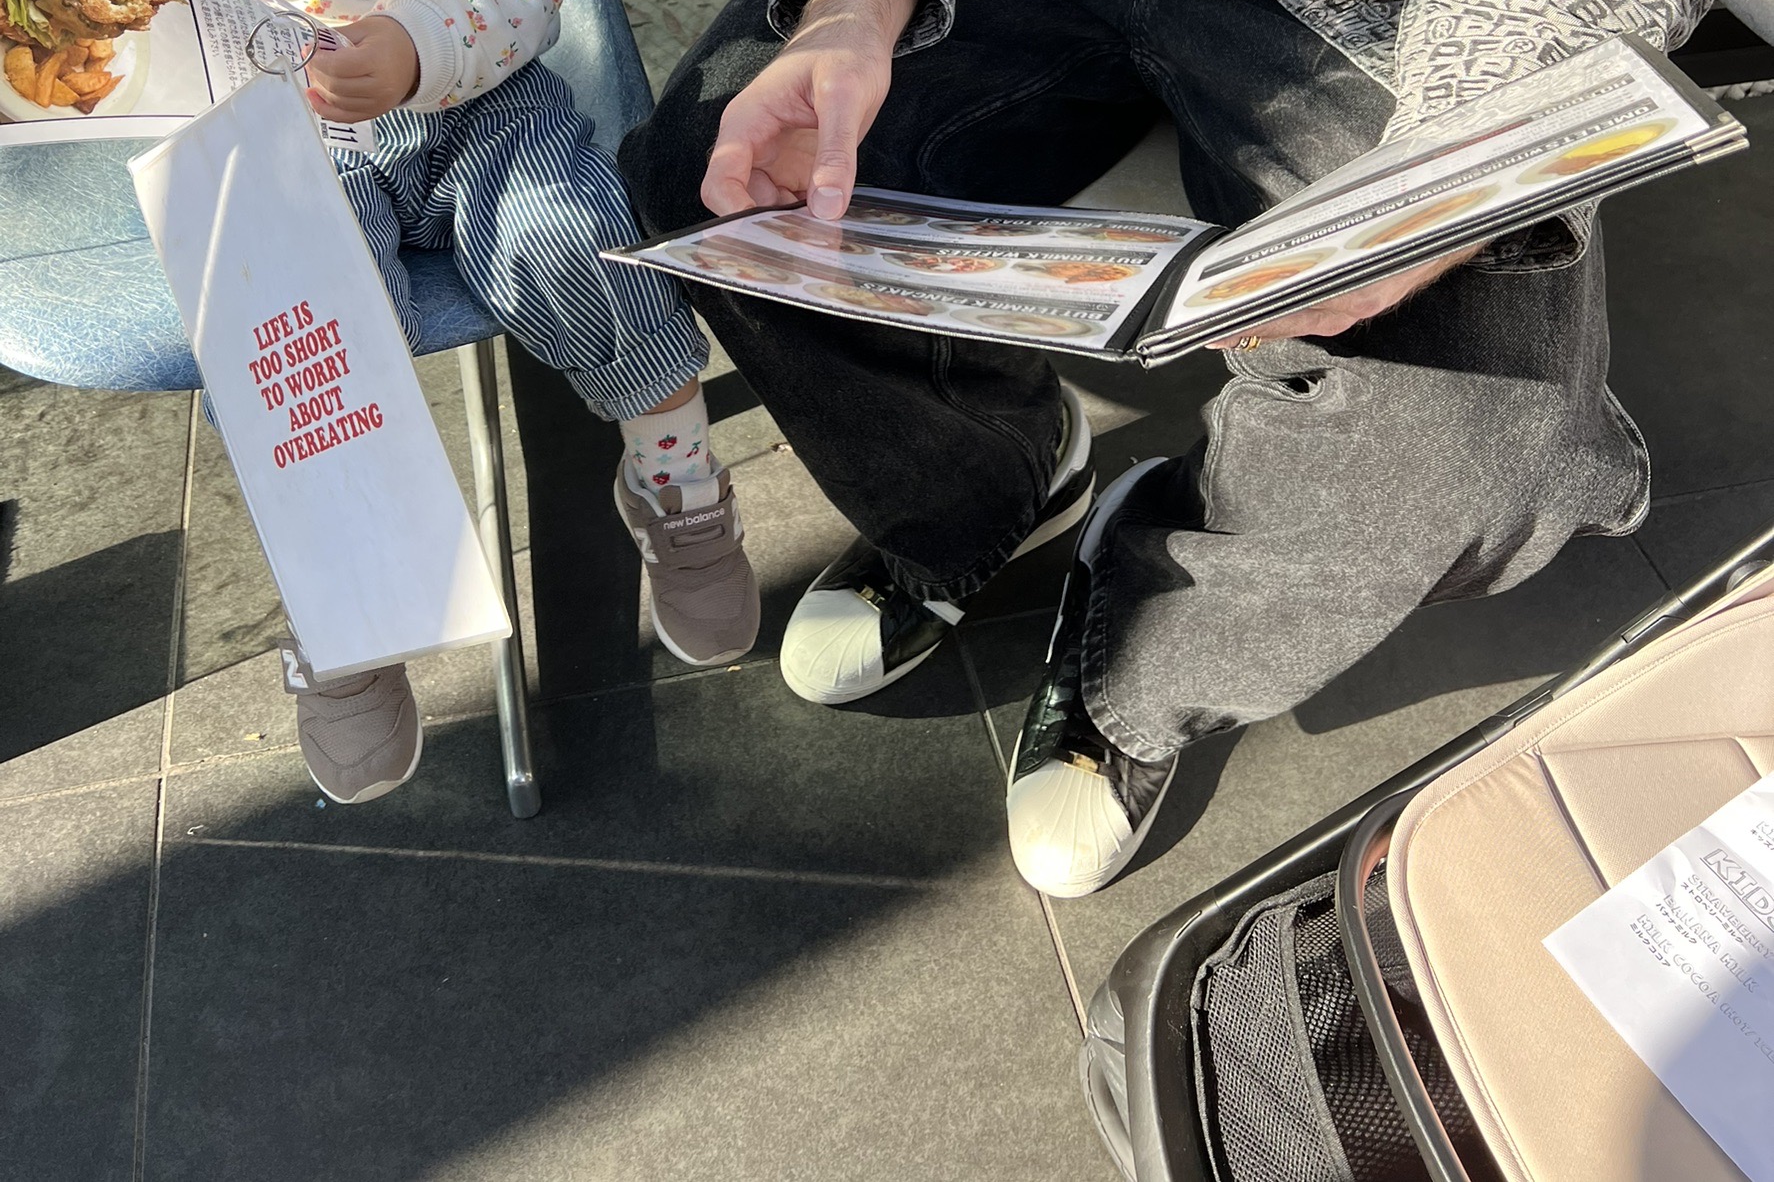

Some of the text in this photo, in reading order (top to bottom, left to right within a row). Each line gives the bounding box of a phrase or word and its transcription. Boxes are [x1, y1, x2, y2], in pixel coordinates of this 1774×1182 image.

[1546, 106, 1650, 148] OMELETS
[936, 248, 1147, 266] BUTTERMILK WAFFLES
[859, 281, 969, 304] PANCAKES
[970, 300, 1103, 321] BUTTERMILK
[253, 300, 314, 350] LIFE IS
[249, 319, 342, 385] TOO SHORT
[260, 348, 351, 411] TO WORRY
[289, 385, 345, 432] ABOUT
[273, 402, 383, 469] OVEREATING
[663, 507, 725, 530] new balance
[1681, 882, 1743, 945] ストロベリーミルク
[1703, 848, 1774, 932] KID
[1656, 903, 1698, 945] バナナミルク
[1688, 874, 1774, 959] STRAWBERRY
[1630, 922, 1671, 967] ミルクココア
[1636, 914, 1675, 954] MILK
[1673, 953, 1722, 1005] COCOA
[1663, 894, 1760, 993] BANANA MILK
